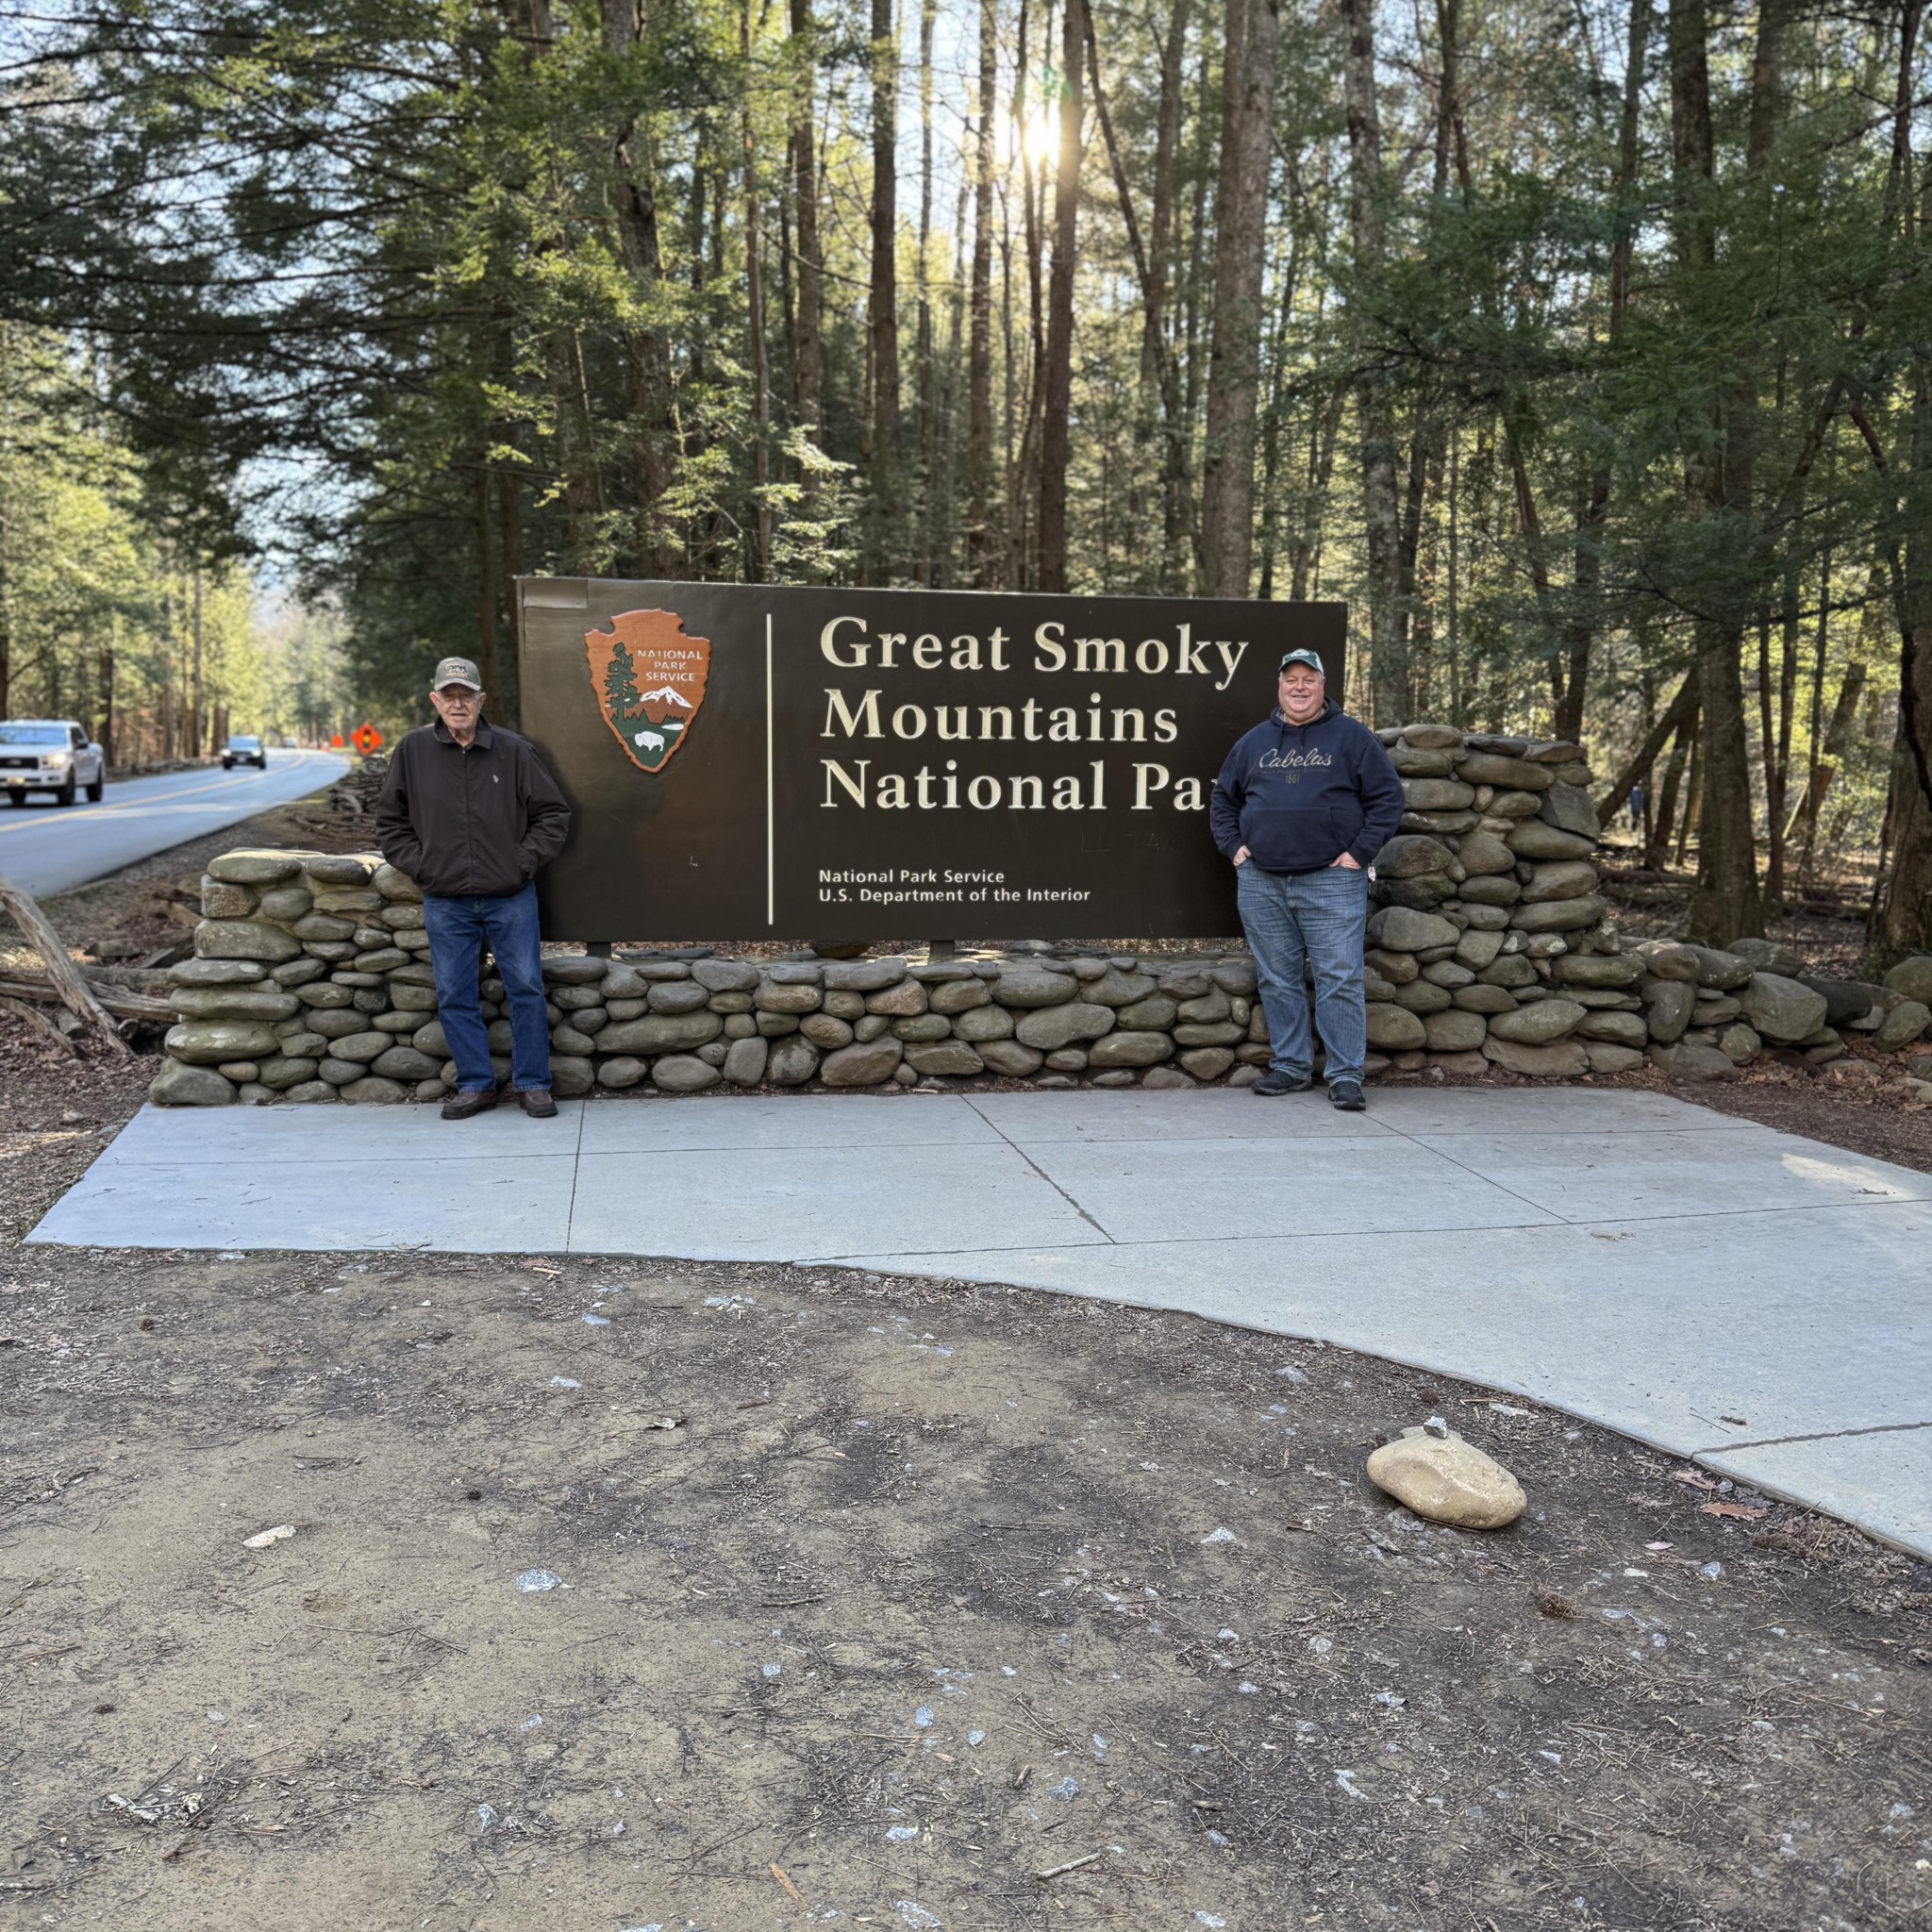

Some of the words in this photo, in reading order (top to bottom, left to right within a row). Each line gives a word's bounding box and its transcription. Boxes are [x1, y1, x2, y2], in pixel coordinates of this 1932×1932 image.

[637, 649, 704, 660] NATIONAL
[820, 616, 1009, 672] Great
[1034, 622, 1249, 691] Smoky
[654, 661, 687, 671] PARK
[645, 672, 695, 682] SERVICE
[820, 689, 1178, 743] Mountains
[1258, 747, 1332, 769] Cabela's
[820, 759, 1107, 810] National
[1131, 762, 1219, 811] Pa
[1285, 774, 1300, 785] 1961
[819, 868, 893, 883] National
[900, 868, 938, 883] Park
[943, 869, 1006, 884] Service
[819, 888, 853, 902] U.S.
[859, 888, 964, 906] Department
[969, 887, 988, 902] of
[992, 887, 1022, 902] the
[1027, 888, 1091, 902] Interior
